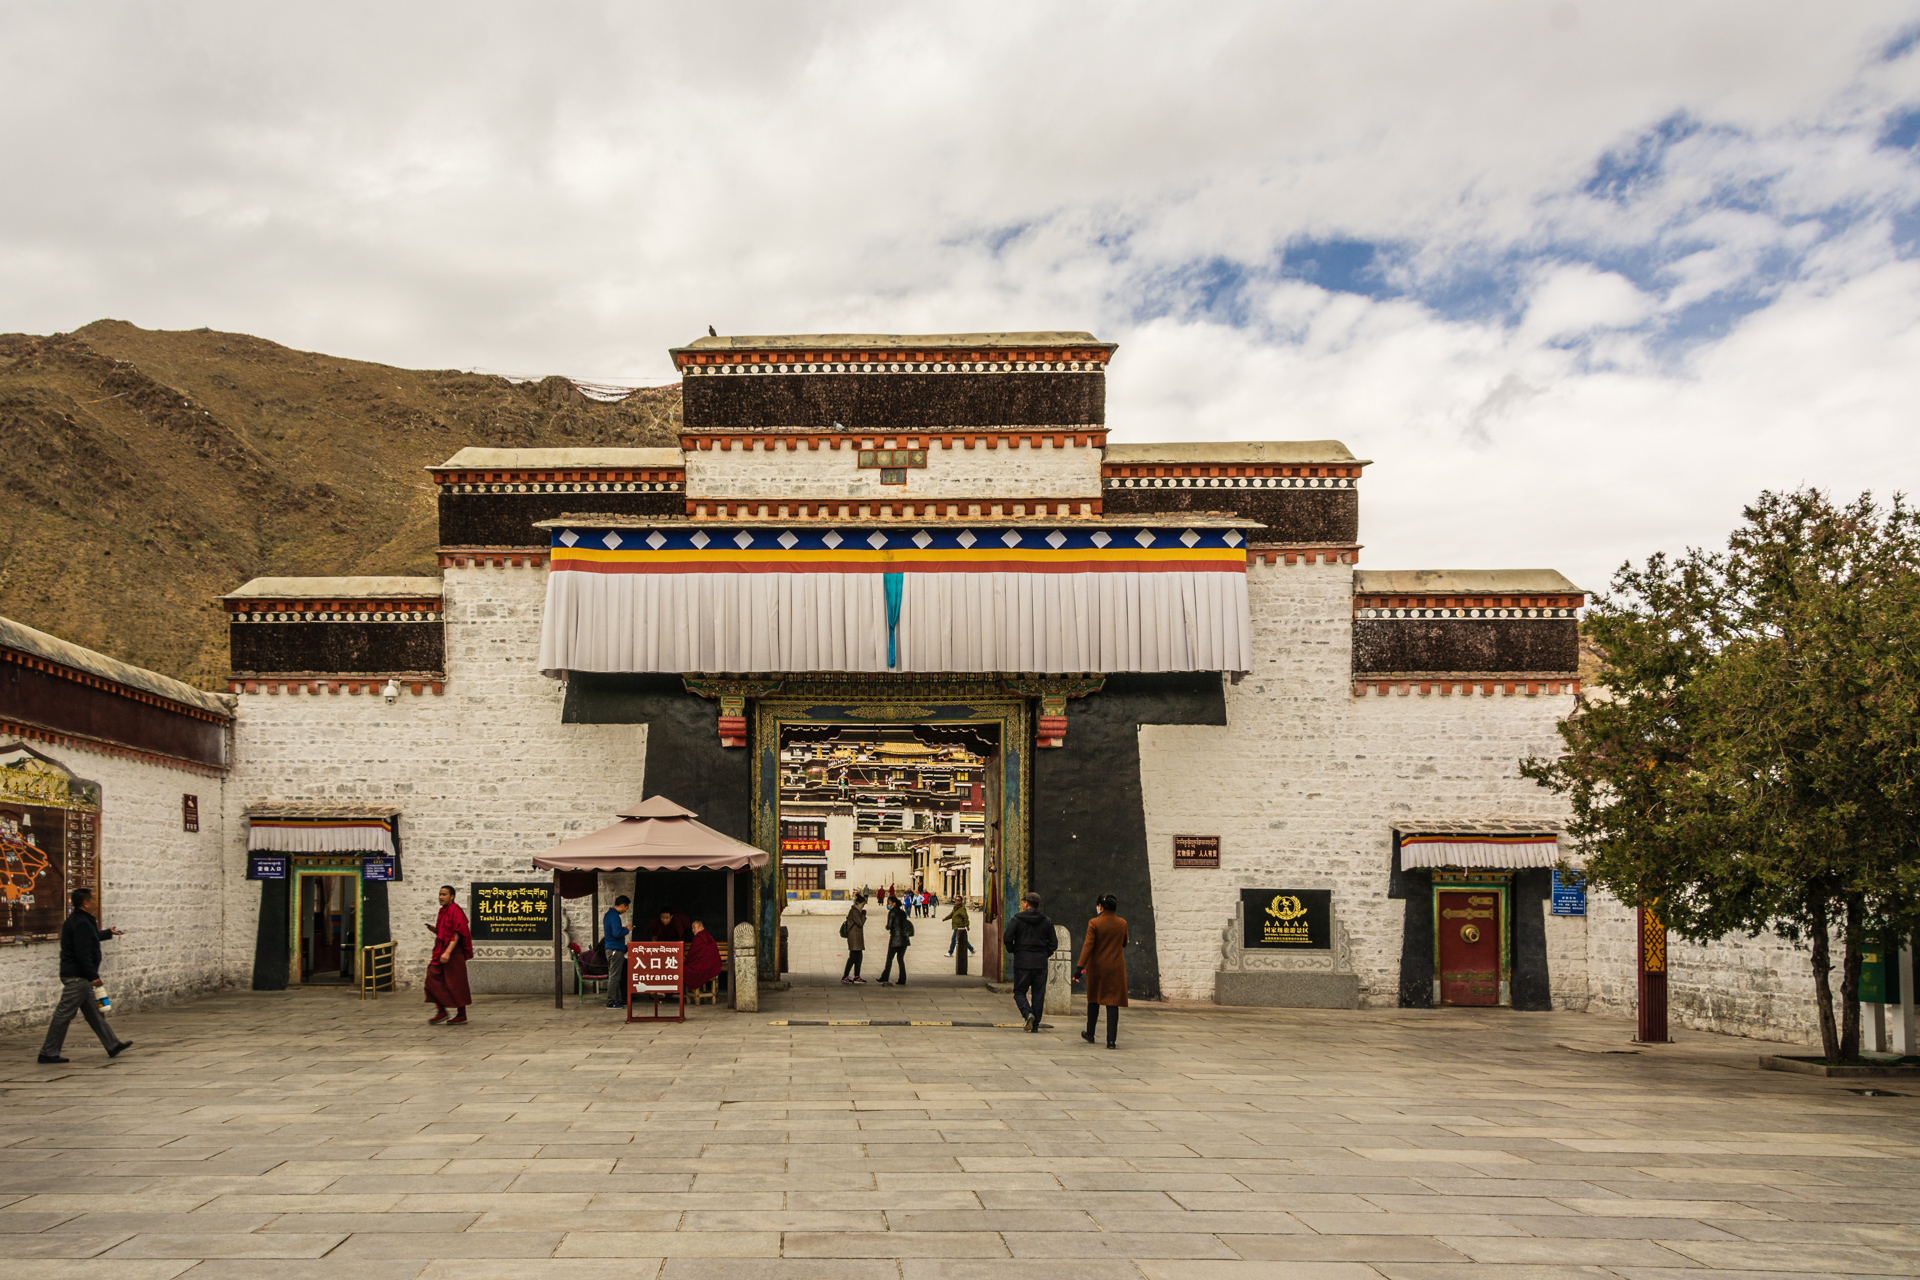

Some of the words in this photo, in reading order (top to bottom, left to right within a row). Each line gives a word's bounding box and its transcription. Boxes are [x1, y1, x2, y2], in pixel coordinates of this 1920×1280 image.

[478, 900, 548, 914] 扎什伦布寺
[495, 915, 517, 923] Lhunpo
[517, 915, 548, 923] Monastery
[633, 956, 678, 970] 入口处
[632, 973, 679, 981] Entrance
